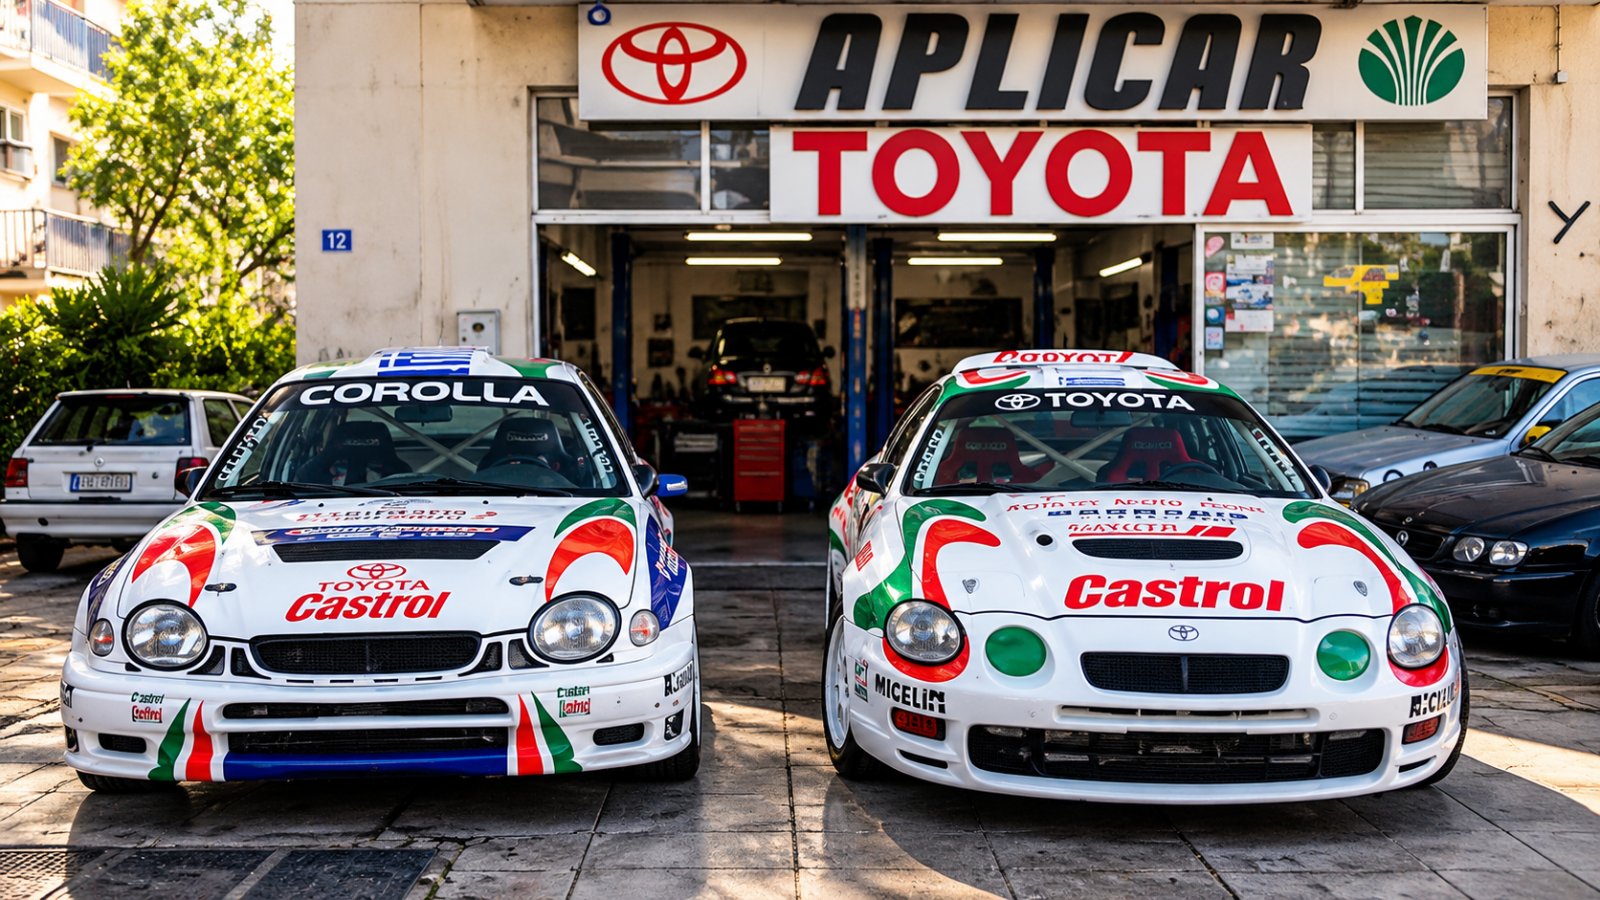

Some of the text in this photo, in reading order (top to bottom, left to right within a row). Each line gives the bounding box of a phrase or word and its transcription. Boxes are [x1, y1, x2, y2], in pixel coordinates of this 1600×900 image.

[793, 12, 1322, 111] APLICAR
[792, 128, 1294, 217] TOYOTA
[327, 231, 347, 249] 12
[299, 381, 550, 407] COROLLA
[1044, 391, 1196, 411] TOYOTA
[318, 579, 430, 592] TOYOTA
[1064, 574, 1285, 612] Castrol
[285, 591, 452, 622] Castrol
